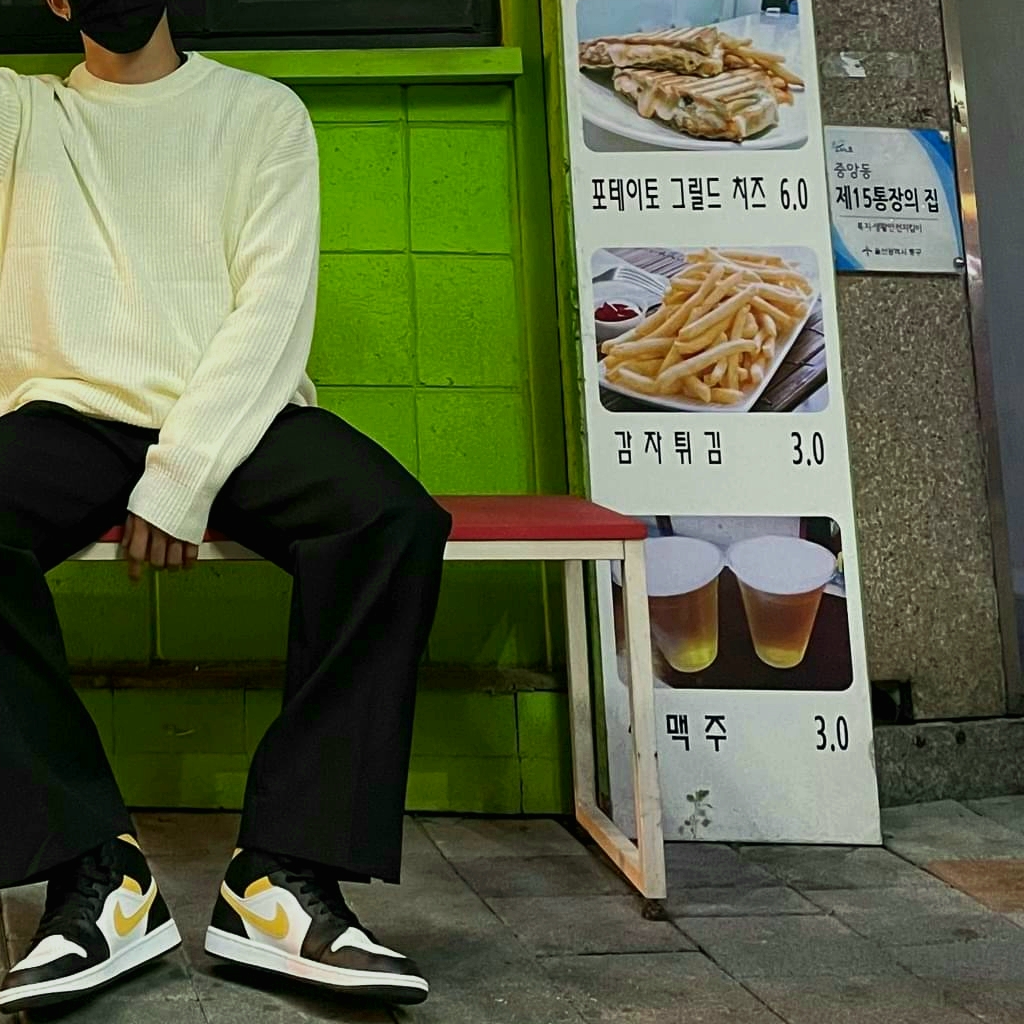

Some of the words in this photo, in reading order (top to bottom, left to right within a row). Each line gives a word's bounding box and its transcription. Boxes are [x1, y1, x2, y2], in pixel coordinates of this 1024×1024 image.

[834, 162, 872, 179] 중앙동
[591, 178, 660, 211] 포테이토
[670, 177, 722, 210] 그릴드
[732, 176, 766, 210] 치즈
[780, 178, 808, 210] 6.0
[835, 185, 919, 213] 제15통장의
[924, 188, 939, 213] 집
[791, 431, 825, 466] 3.0
[814, 715, 849, 752] 3.0
